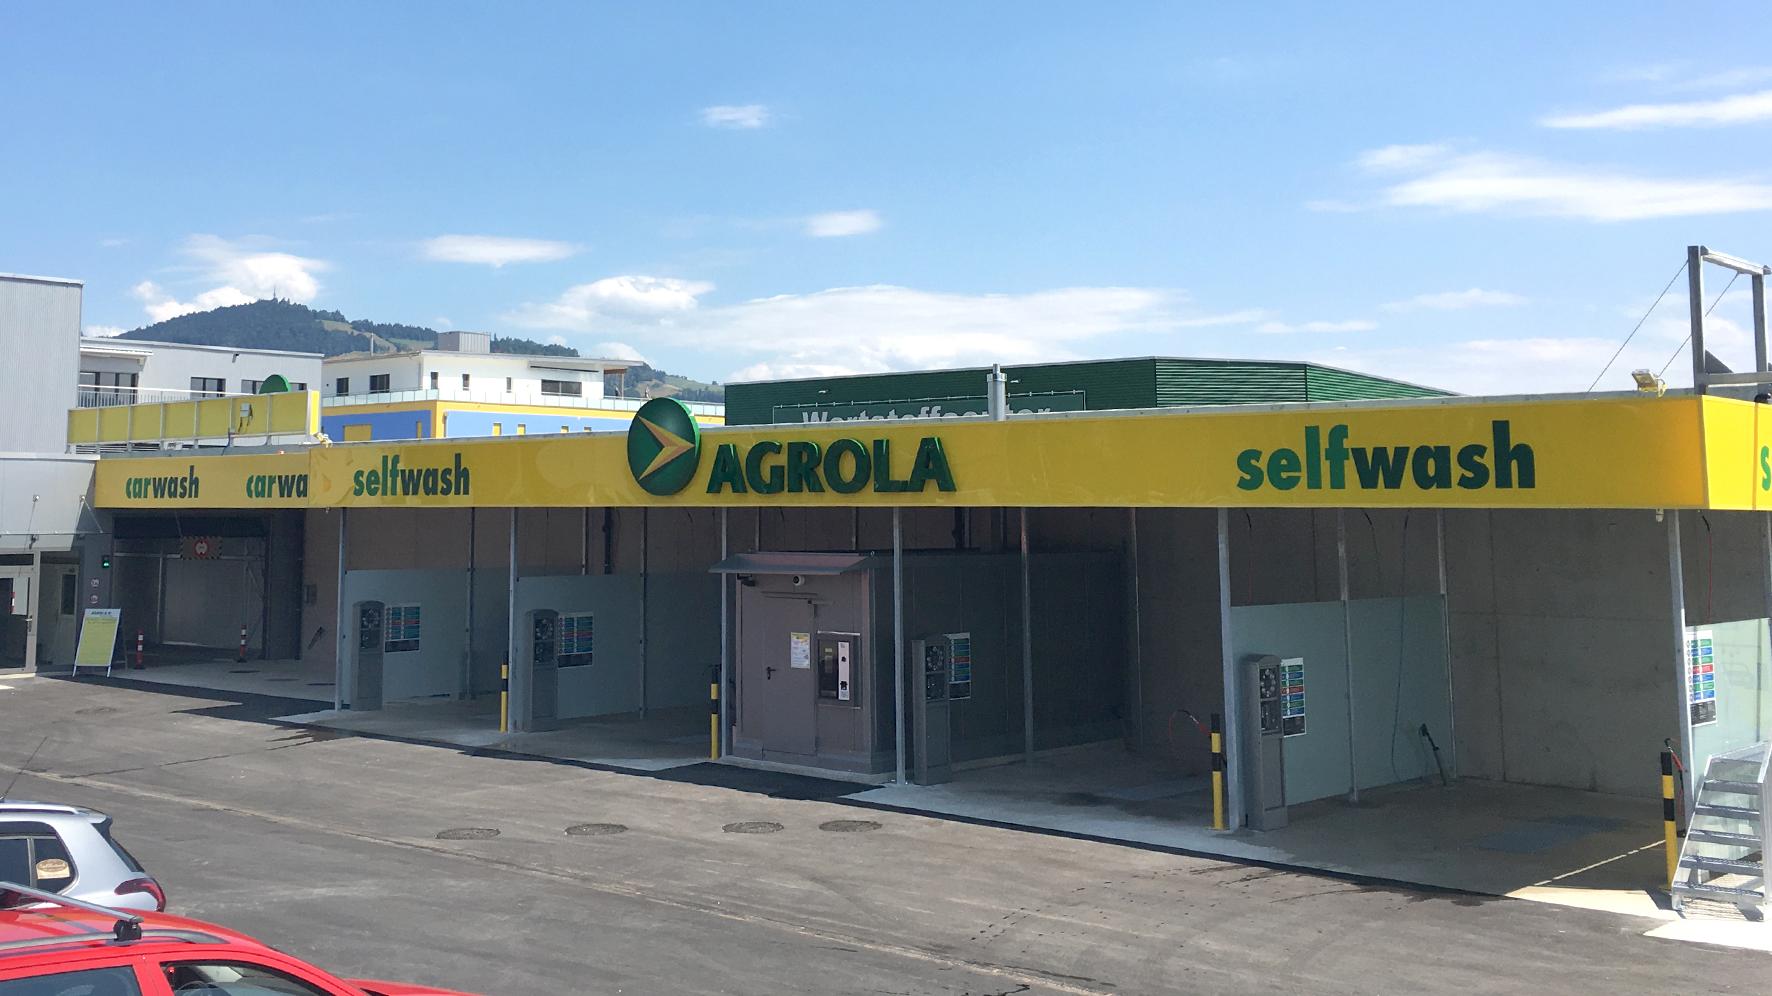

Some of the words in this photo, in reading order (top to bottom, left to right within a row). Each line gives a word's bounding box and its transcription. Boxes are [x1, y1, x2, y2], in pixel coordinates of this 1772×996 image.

[353, 453, 470, 497] selfwash
[706, 437, 957, 494] AGROLA
[1236, 420, 1536, 491] selfwash
[125, 465, 199, 499] carwash
